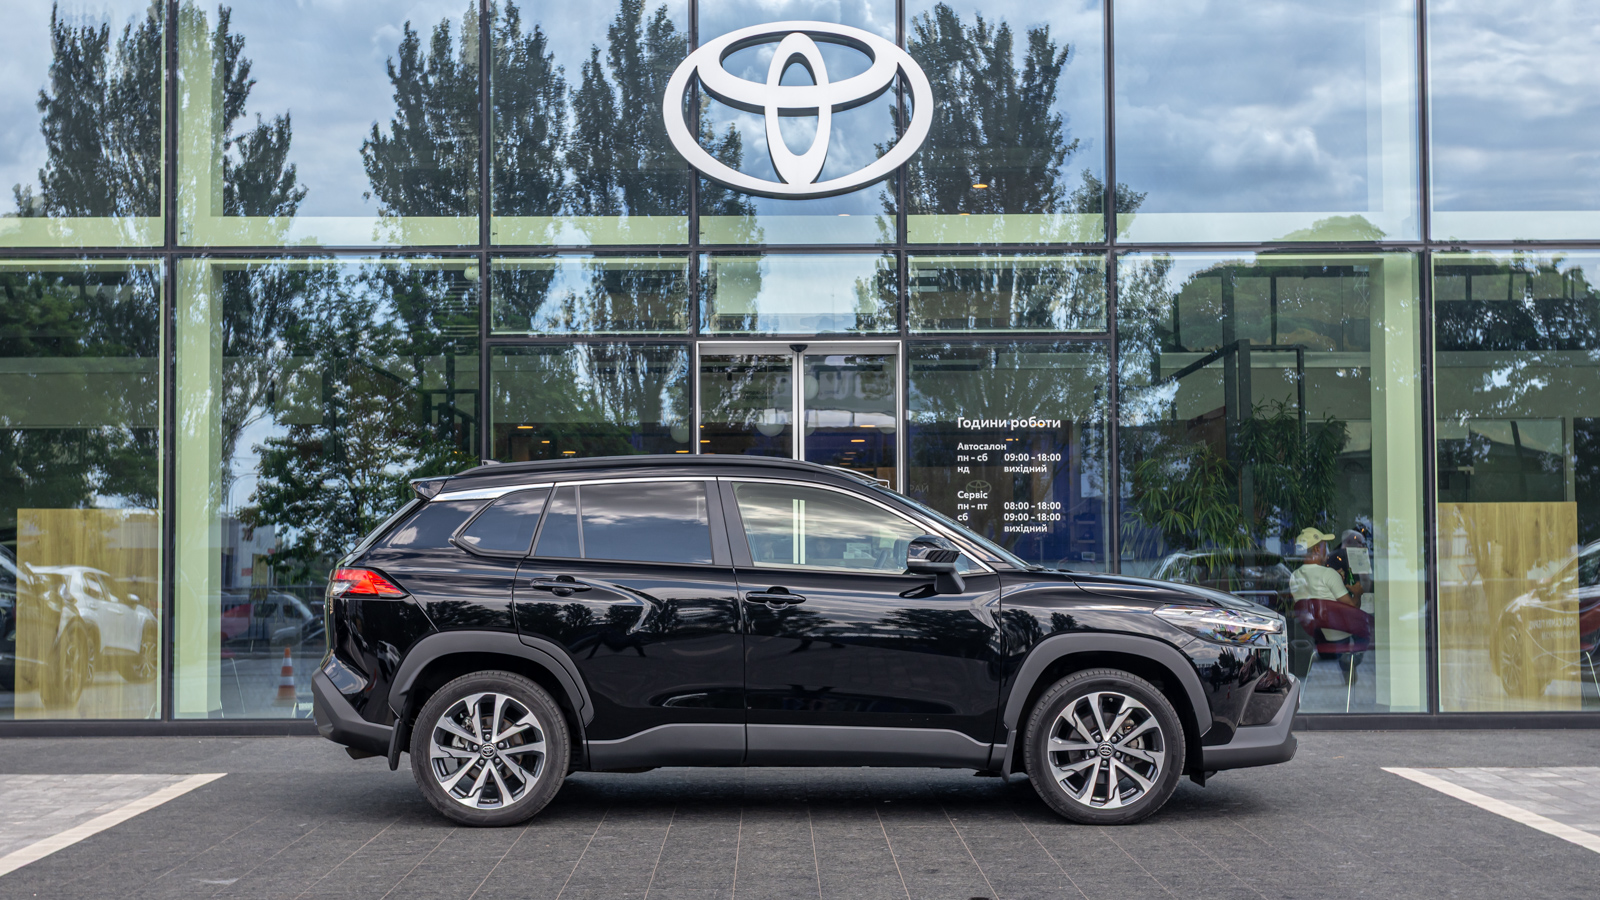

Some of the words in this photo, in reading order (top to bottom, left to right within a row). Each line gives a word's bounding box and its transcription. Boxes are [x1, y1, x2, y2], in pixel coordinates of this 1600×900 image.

[957, 417, 1007, 429] Години
[1010, 416, 1061, 431] роботи
[957, 442, 1007, 451] Автосалон
[957, 454, 969, 462] пн
[977, 453, 988, 462] сб
[1004, 453, 1029, 462] 09:00
[1037, 453, 1061, 462] 18:00
[957, 466, 970, 474] нд
[1004, 464, 1047, 473] вихідний
[957, 491, 988, 501] Сервіс
[957, 503, 969, 511] пн
[1004, 502, 1029, 511] 08:00
[1037, 502, 1061, 511] 18:00
[957, 513, 968, 521] сб
[1004, 513, 1029, 522] 09:00
[1037, 513, 1061, 522] 18:00
[1004, 524, 1048, 533] вихідний
